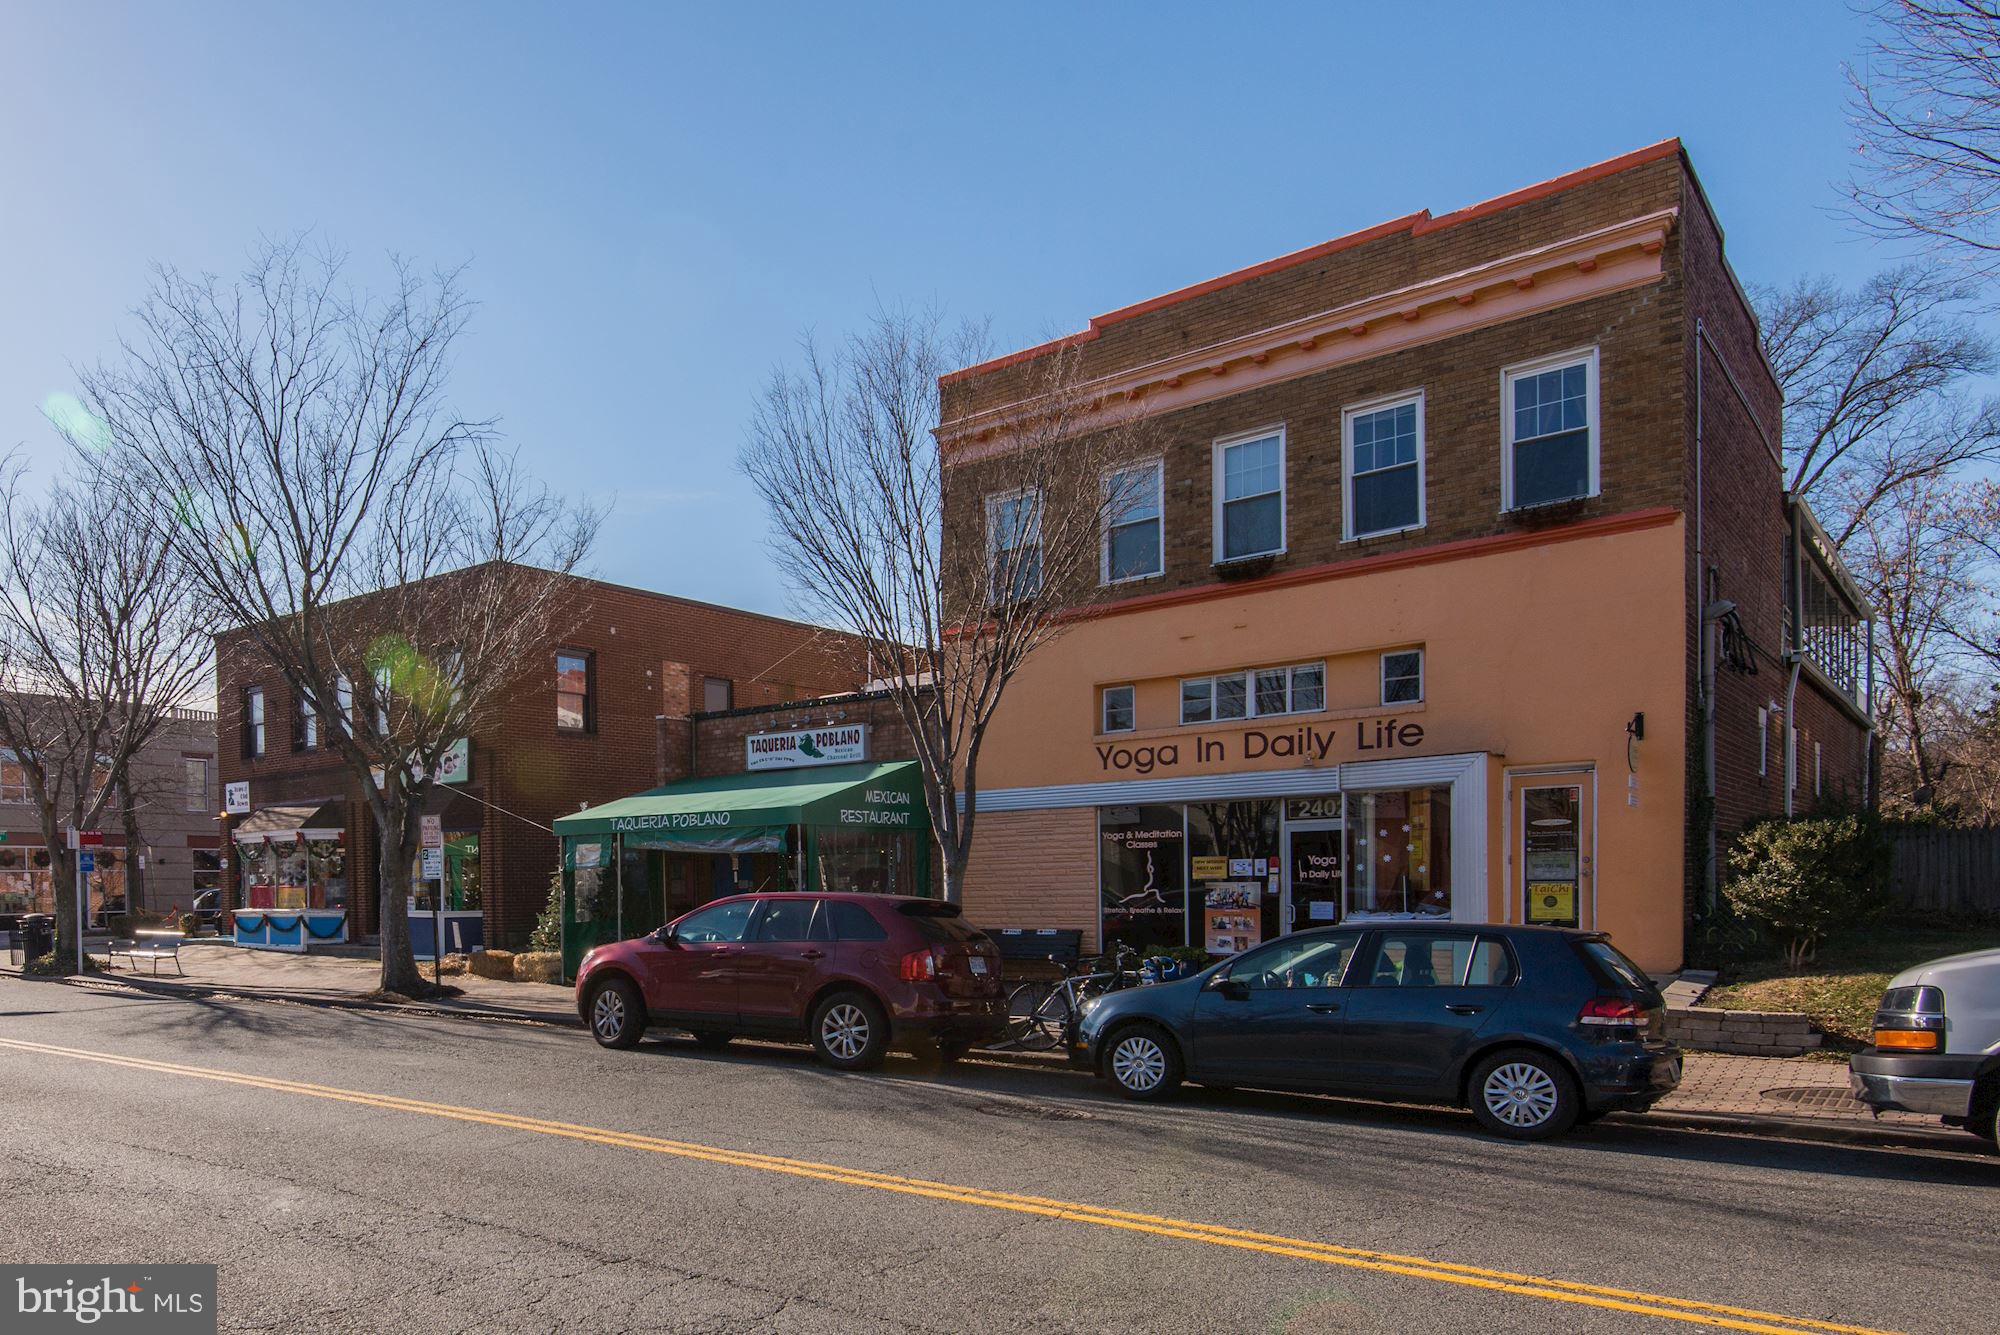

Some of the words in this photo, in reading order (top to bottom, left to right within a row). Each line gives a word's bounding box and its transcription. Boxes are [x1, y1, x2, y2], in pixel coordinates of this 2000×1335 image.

[750, 735, 797, 755] TAQUERIA
[816, 729, 861, 748] POBLANO
[1096, 744, 1178, 774] Yoga
[1197, 736, 1225, 763] In
[1244, 726, 1336, 760] Daily
[1358, 719, 1425, 750] Life
[865, 789, 910, 804] MEXICAN
[610, 815, 670, 831] TAQUERIA
[672, 811, 731, 828] POBLANO
[840, 809, 910, 825] RESTAURANT
[1103, 831, 1125, 841] Yoga
[1126, 831, 1134, 839] &
[1135, 829, 1183, 839] Meditation
[1126, 841, 1158, 849] Classes
[423, 850, 428, 858] 2
[1308, 855, 1337, 867] Yoga
[1309, 869, 1330, 879] Daily
